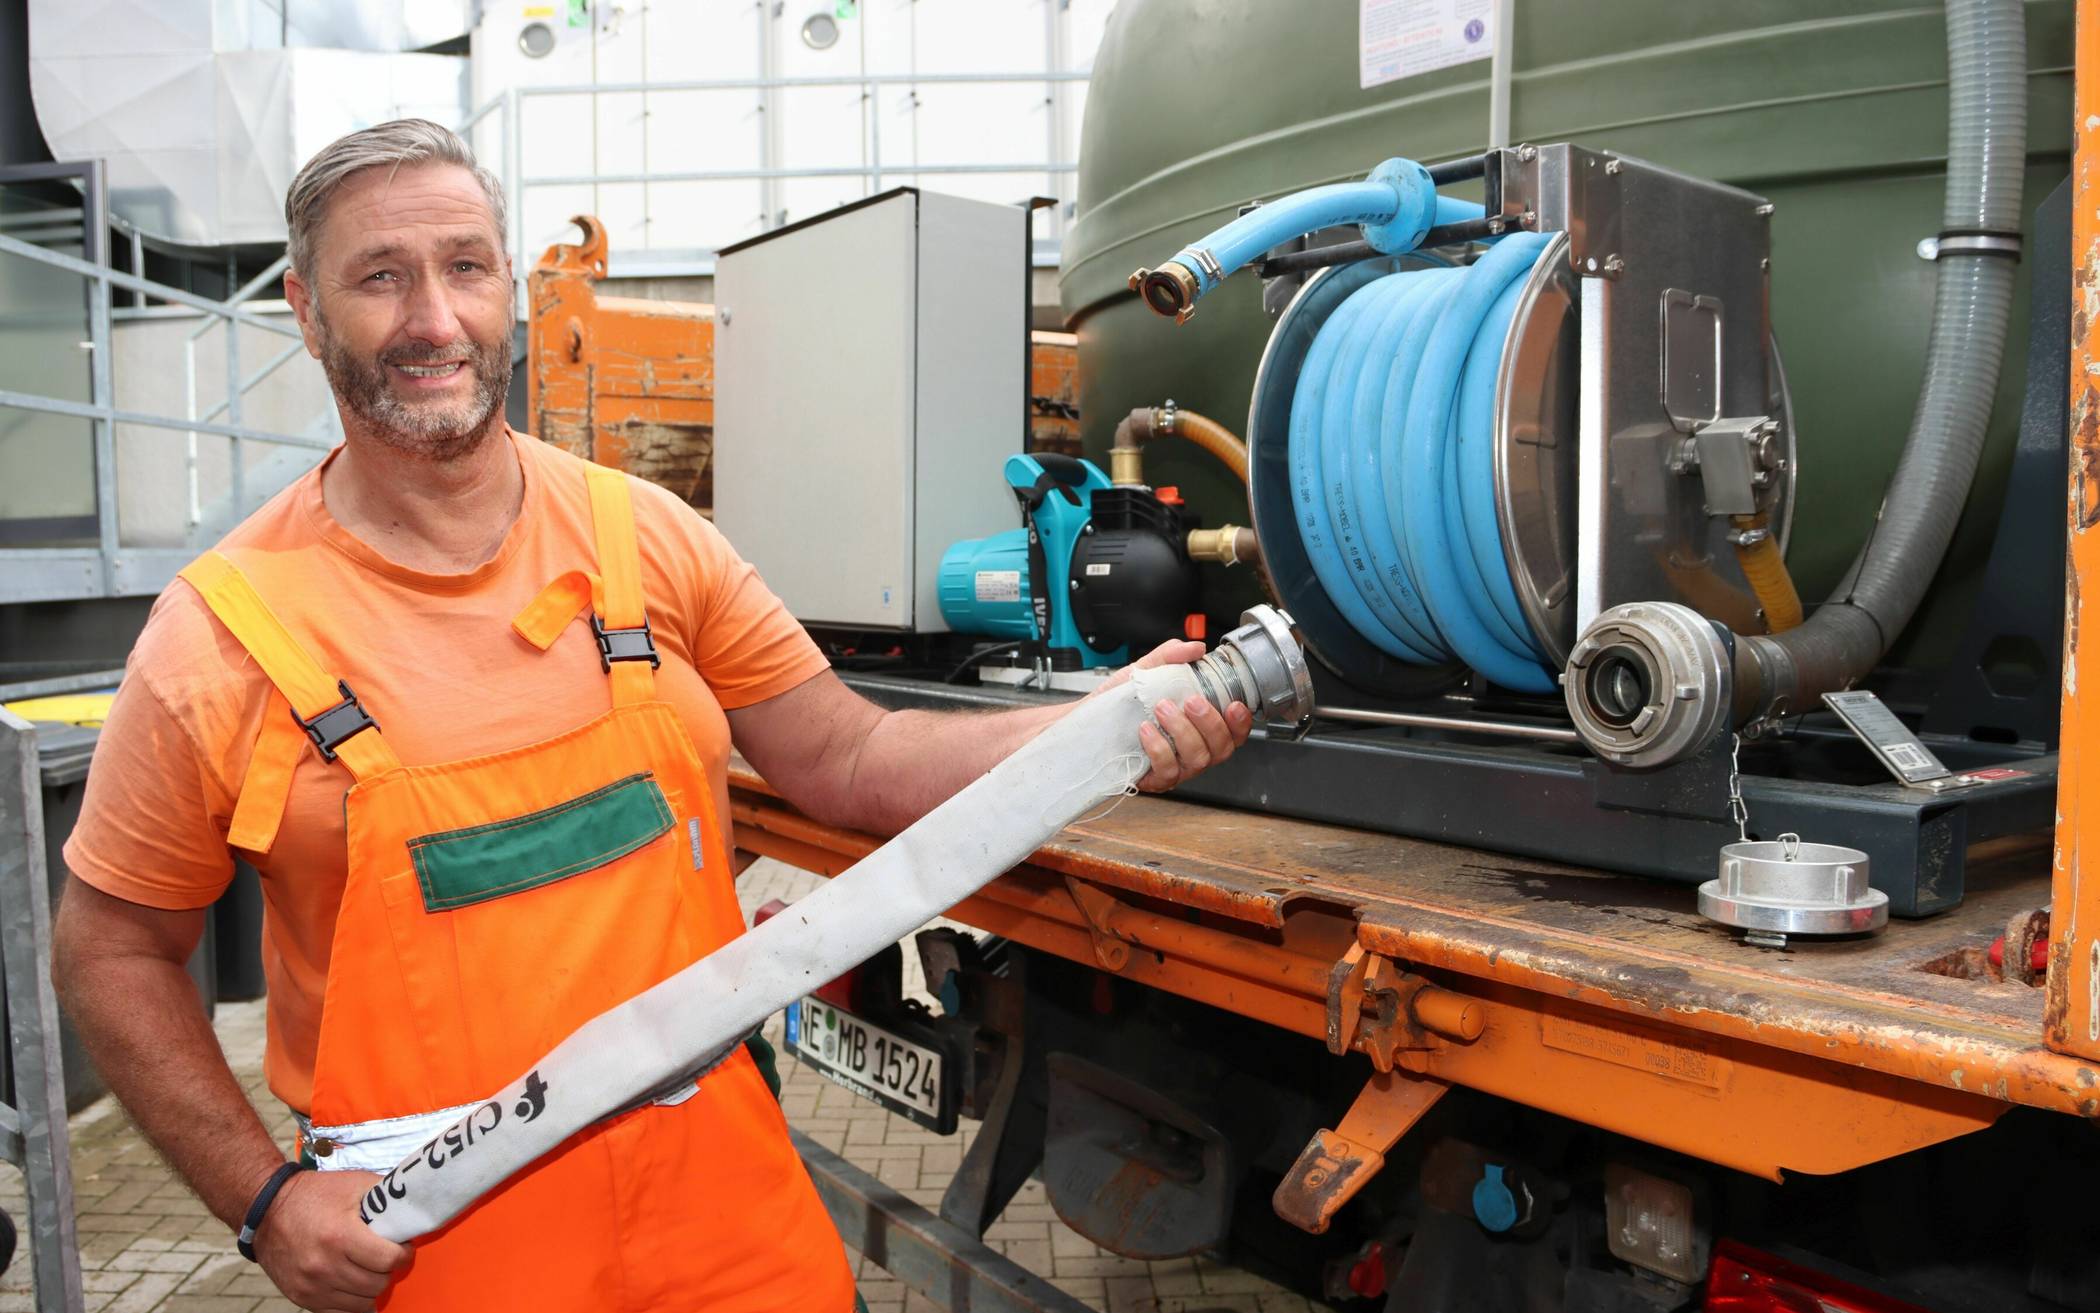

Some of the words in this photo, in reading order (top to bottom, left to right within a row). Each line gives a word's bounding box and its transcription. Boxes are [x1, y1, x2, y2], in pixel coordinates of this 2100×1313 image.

[799, 1002, 822, 1052] NE
[837, 1019, 868, 1073] MB
[872, 1036, 935, 1107] 1524
